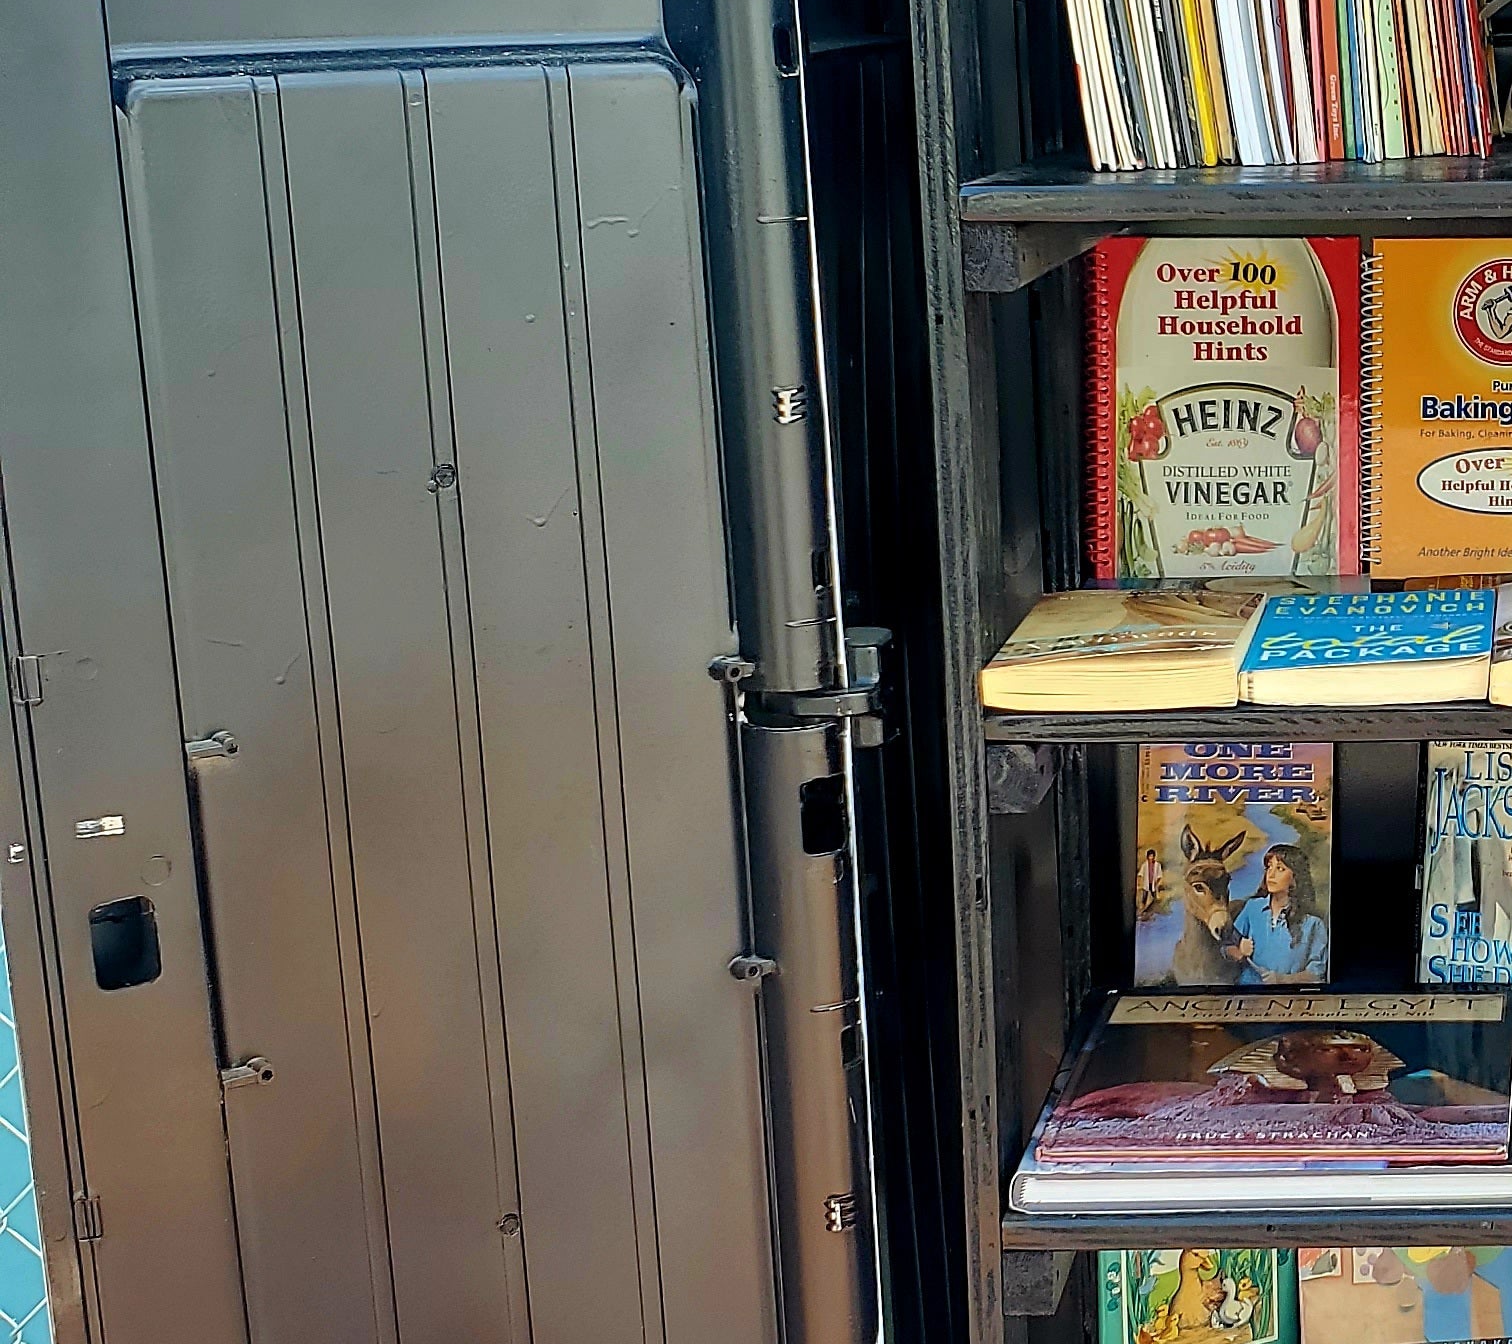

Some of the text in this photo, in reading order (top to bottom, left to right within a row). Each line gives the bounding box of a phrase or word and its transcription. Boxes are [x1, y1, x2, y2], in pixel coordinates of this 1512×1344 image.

[1157, 261, 1276, 285] Over 100
[1174, 290, 1277, 315] Helpful
[1460, 281, 1482, 320] ARM
[1485, 269, 1498, 284] &
[1158, 316, 1302, 336] Household
[1193, 342, 1267, 361] Hints
[1173, 399, 1284, 439] HEINZ
[1163, 465, 1291, 478] DISTILLED WHITE
[1455, 456, 1505, 474] Over
[1166, 481, 1290, 505] VINEGAR
[1441, 480, 1495, 494] Helpful
[1280, 591, 1485, 606] STEPHANIE
[1275, 602, 1485, 616] EVANOVICH
[1262, 624, 1485, 649] total
[1351, 623, 1403, 632] THE
[1259, 642, 1483, 661] PACKAGE
[1183, 743, 1293, 759] ONE
[1159, 763, 1315, 780] MORE
[1155, 786, 1318, 804] RIVER
[1430, 904, 1483, 939] SEE
[1427, 955, 1487, 986] SHE
